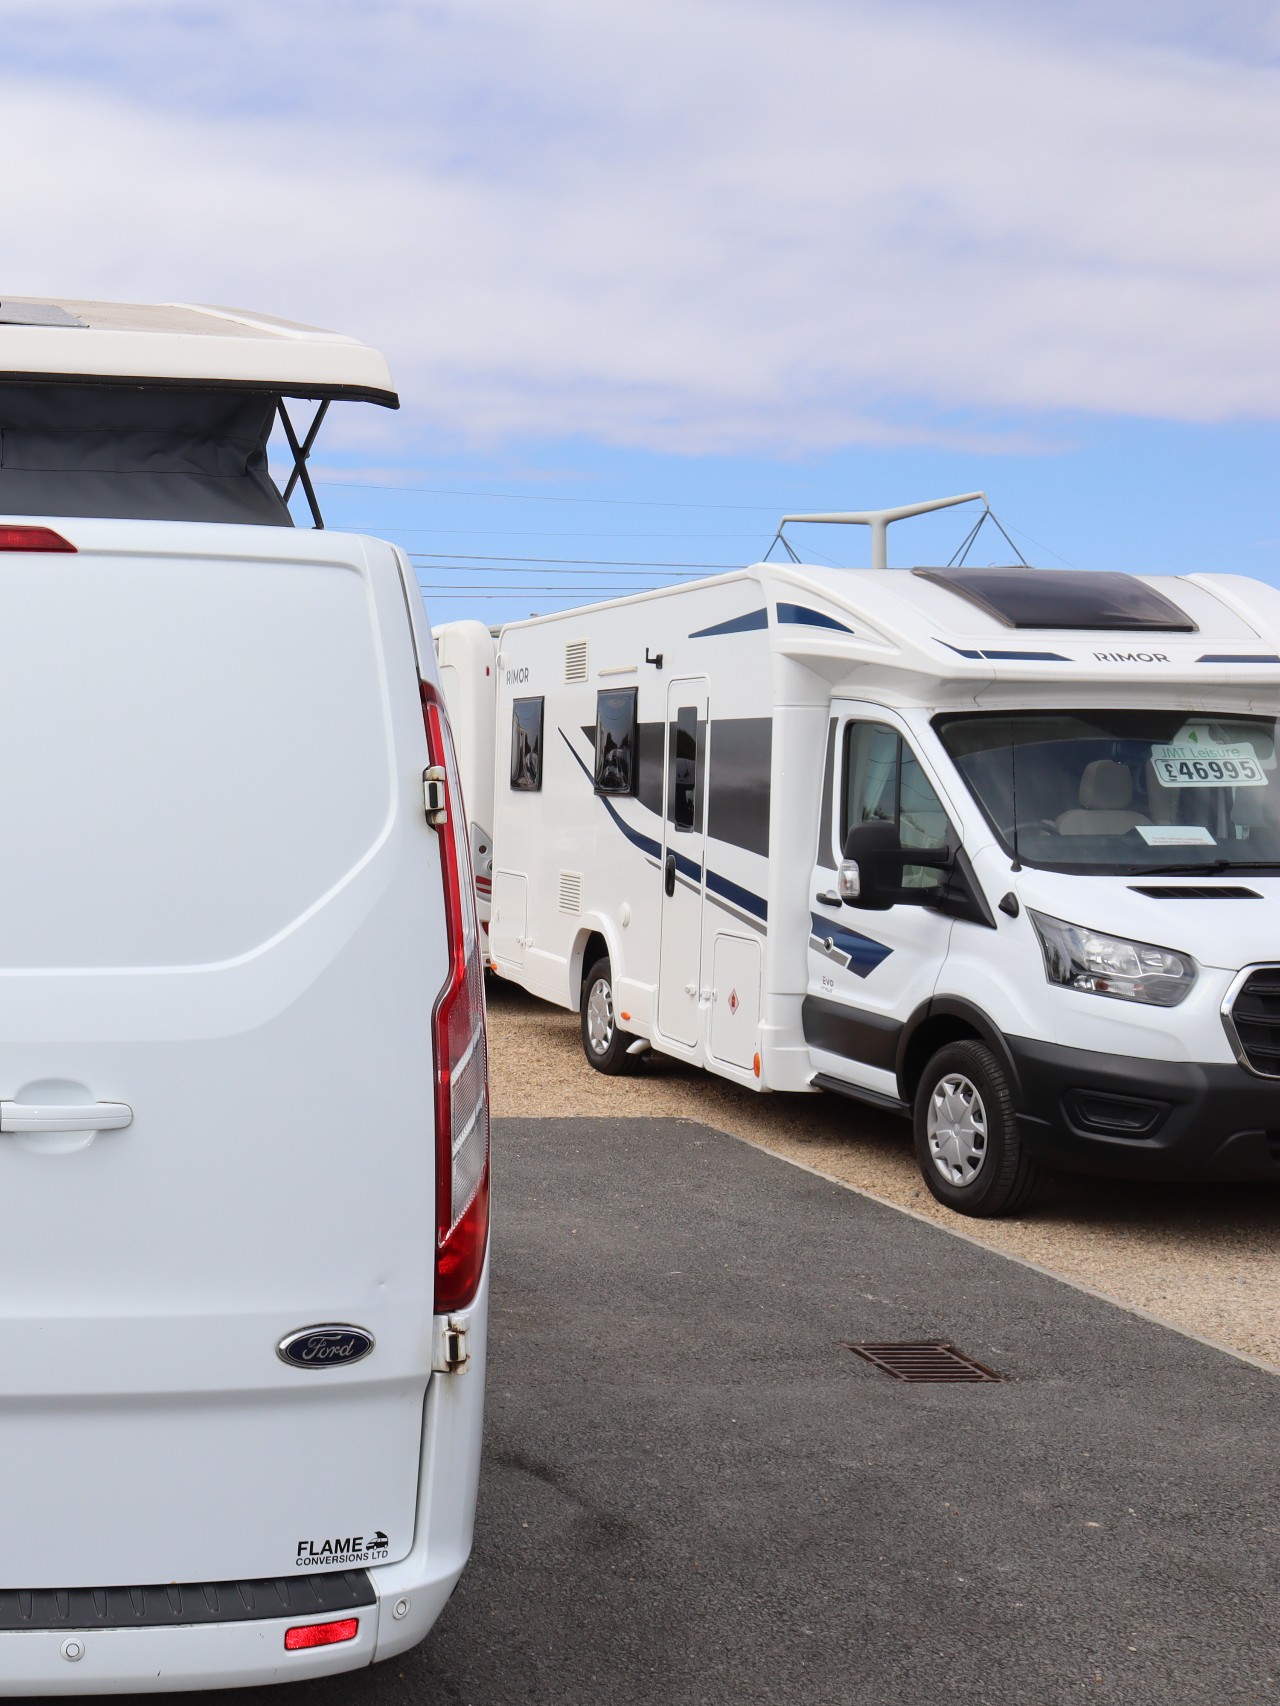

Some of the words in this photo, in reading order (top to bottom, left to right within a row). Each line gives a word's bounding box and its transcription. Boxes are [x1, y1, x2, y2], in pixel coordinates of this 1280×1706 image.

[1092, 652, 1172, 662] RIMOR
[506, 667, 529, 685] RIMOR
[1161, 747, 1188, 758] JMT
[1189, 747, 1240, 758] Leisure
[1164, 761, 1257, 781] £46995
[302, 1335, 355, 1360] Ford
[297, 1537, 364, 1556] FLAME
[296, 1552, 369, 1566] CONVERSIONS
[371, 1550, 389, 1560] LTD
